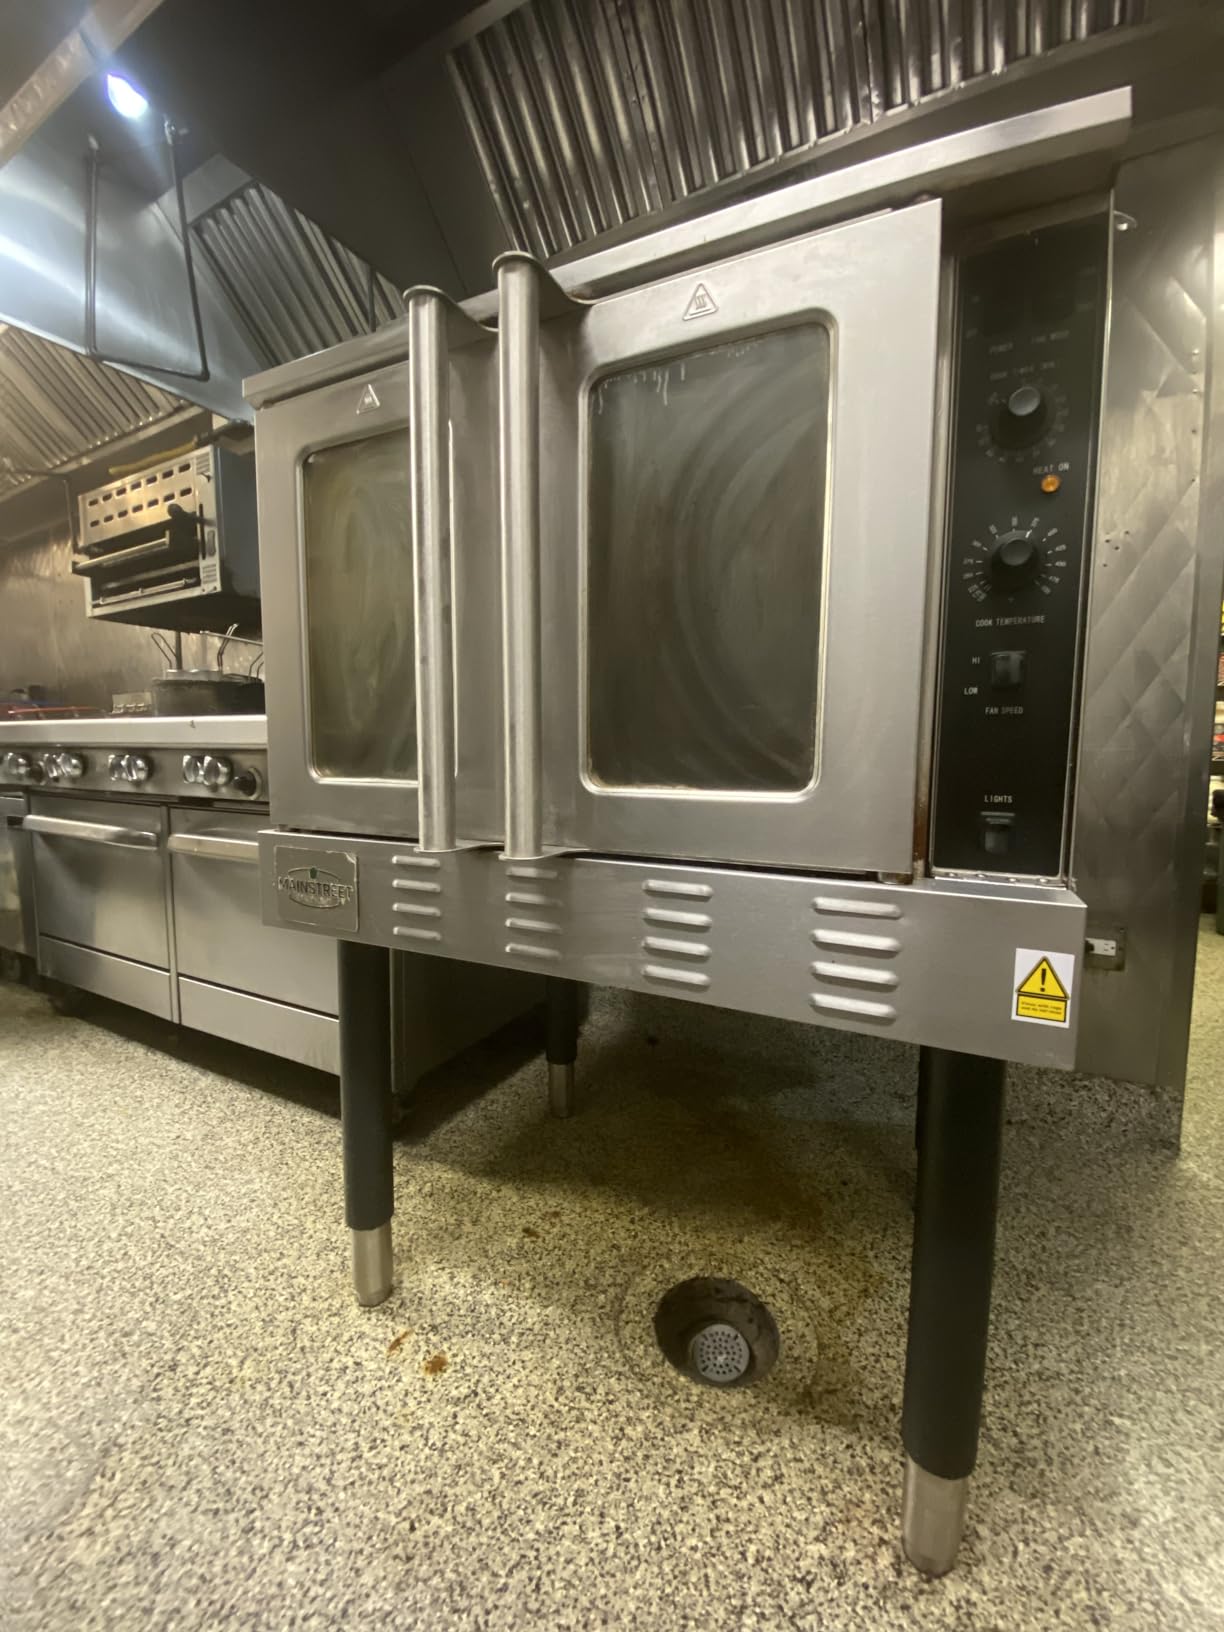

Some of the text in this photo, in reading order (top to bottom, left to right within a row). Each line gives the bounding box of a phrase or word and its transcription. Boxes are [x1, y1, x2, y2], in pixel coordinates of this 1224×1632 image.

[1033, 462, 1070, 475] HEAT ON
[975, 616, 1045, 627] COOK TEMPERATURE
[972, 656, 980, 664] HI
[964, 687, 978, 695] LOW
[985, 705, 1024, 715] FAN SPEED
[984, 795, 1013, 803] LIGHTS
[278, 876, 353, 900] MAINSTREET
